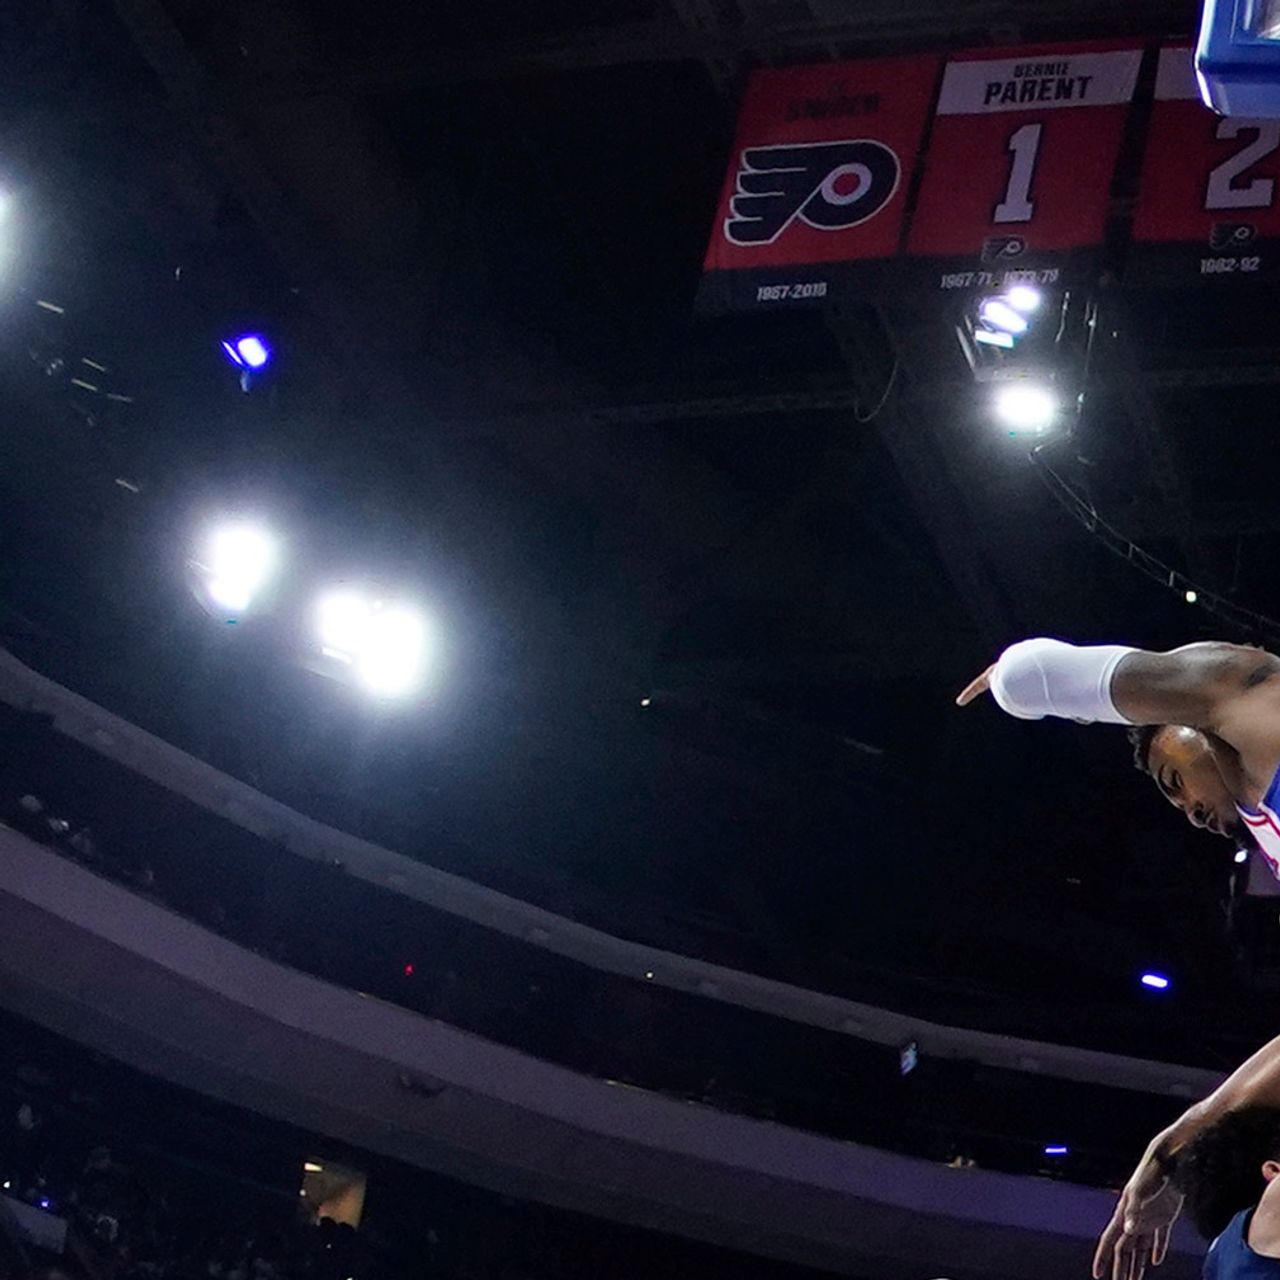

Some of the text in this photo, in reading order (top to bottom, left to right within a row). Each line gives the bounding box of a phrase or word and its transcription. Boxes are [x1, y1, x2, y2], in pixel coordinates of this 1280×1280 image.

[985, 75, 1091, 105] PARENT
[994, 122, 1043, 223] 1
[1205, 117, 1280, 210] 2
